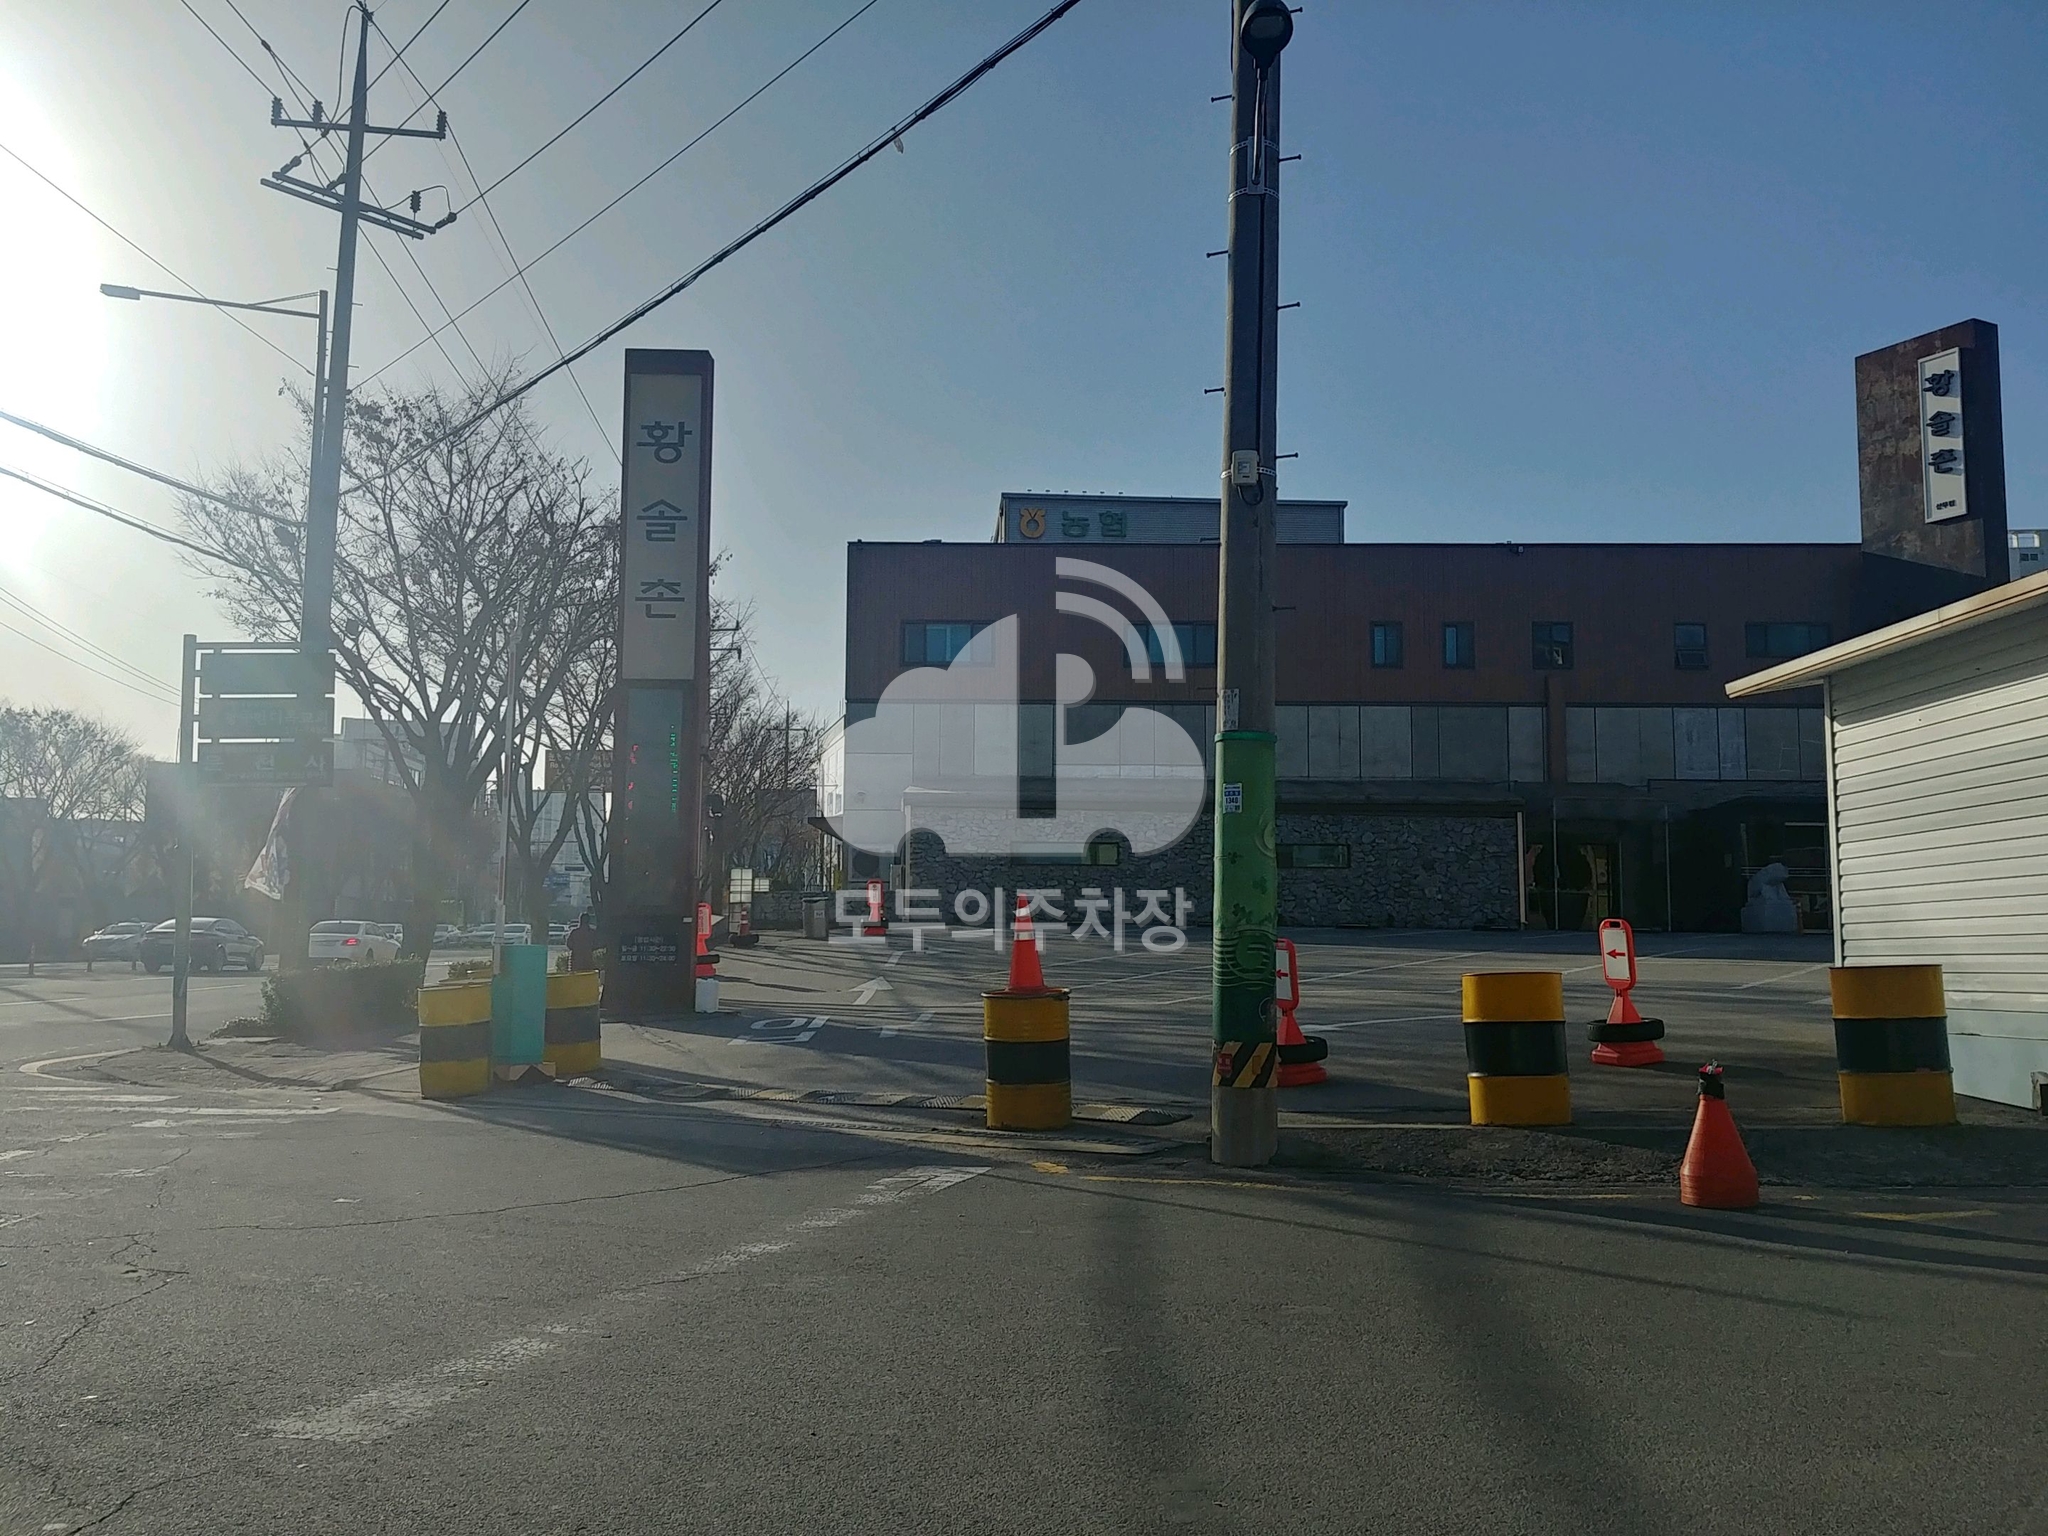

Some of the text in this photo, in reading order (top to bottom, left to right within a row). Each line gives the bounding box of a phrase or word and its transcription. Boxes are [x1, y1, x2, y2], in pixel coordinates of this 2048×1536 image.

[1923, 369, 1958, 475] 황솔촌
[634, 421, 692, 619] 황솔촌
[1061, 510, 1127, 538] 농협
